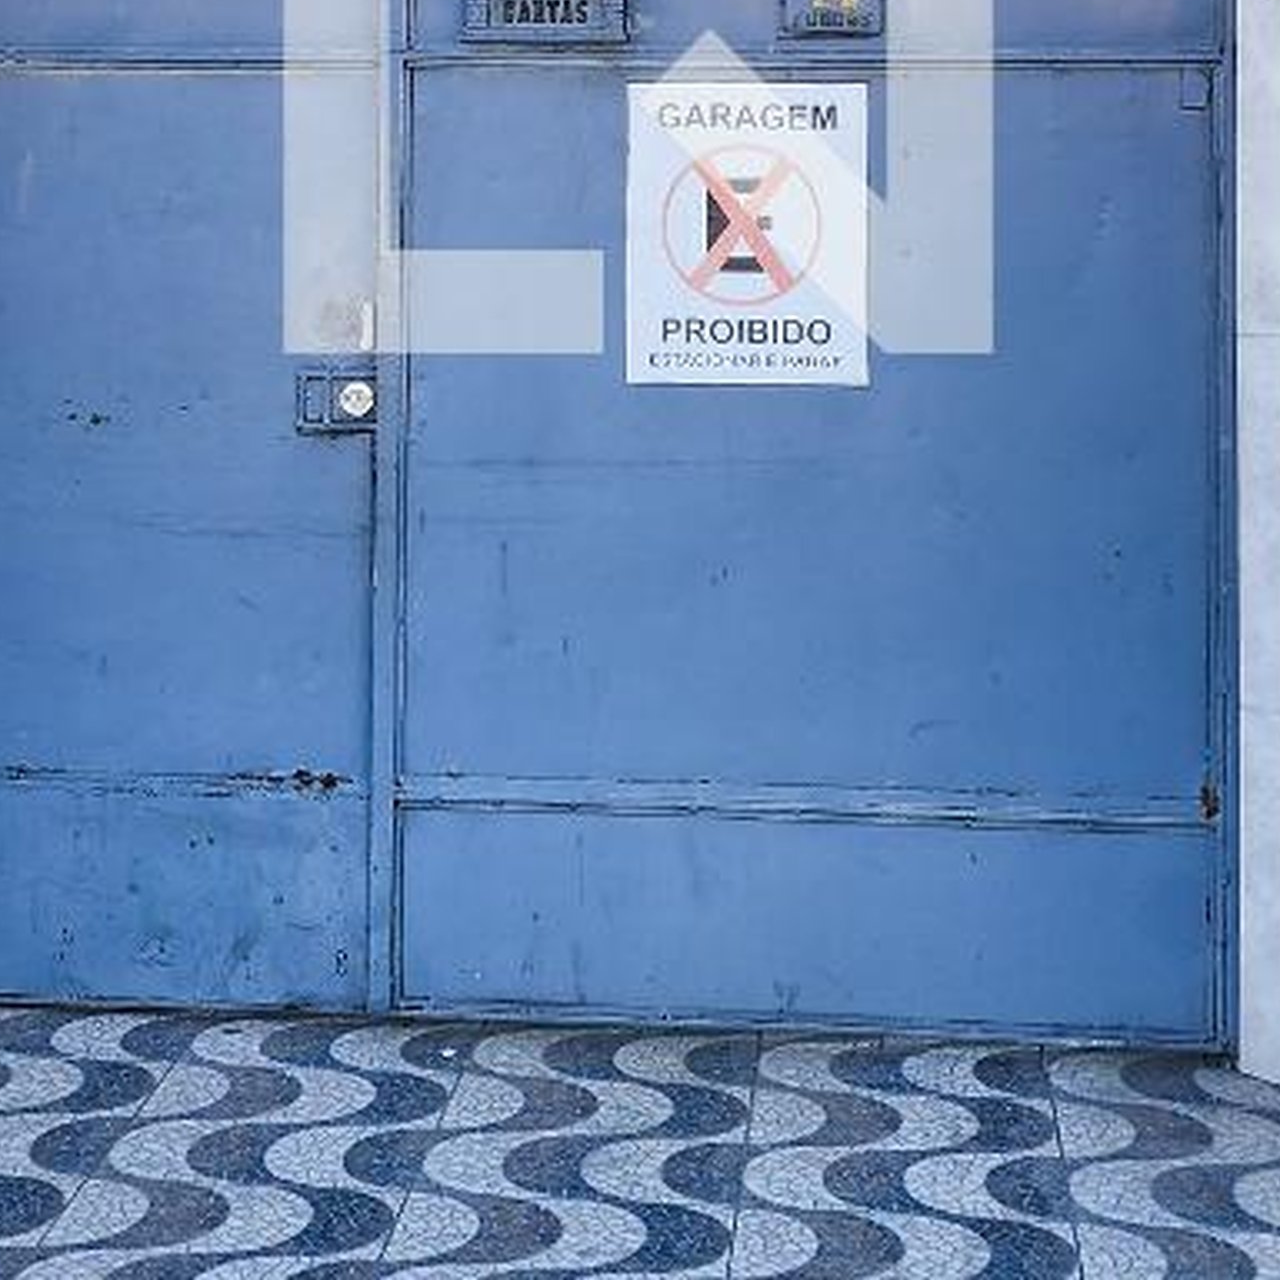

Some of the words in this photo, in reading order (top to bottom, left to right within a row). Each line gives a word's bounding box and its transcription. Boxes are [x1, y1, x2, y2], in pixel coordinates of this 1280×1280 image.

[503, 0, 588, 24] CARTAS
[658, 103, 838, 131] GARAGEM
[662, 318, 832, 345] PROIBIDO
